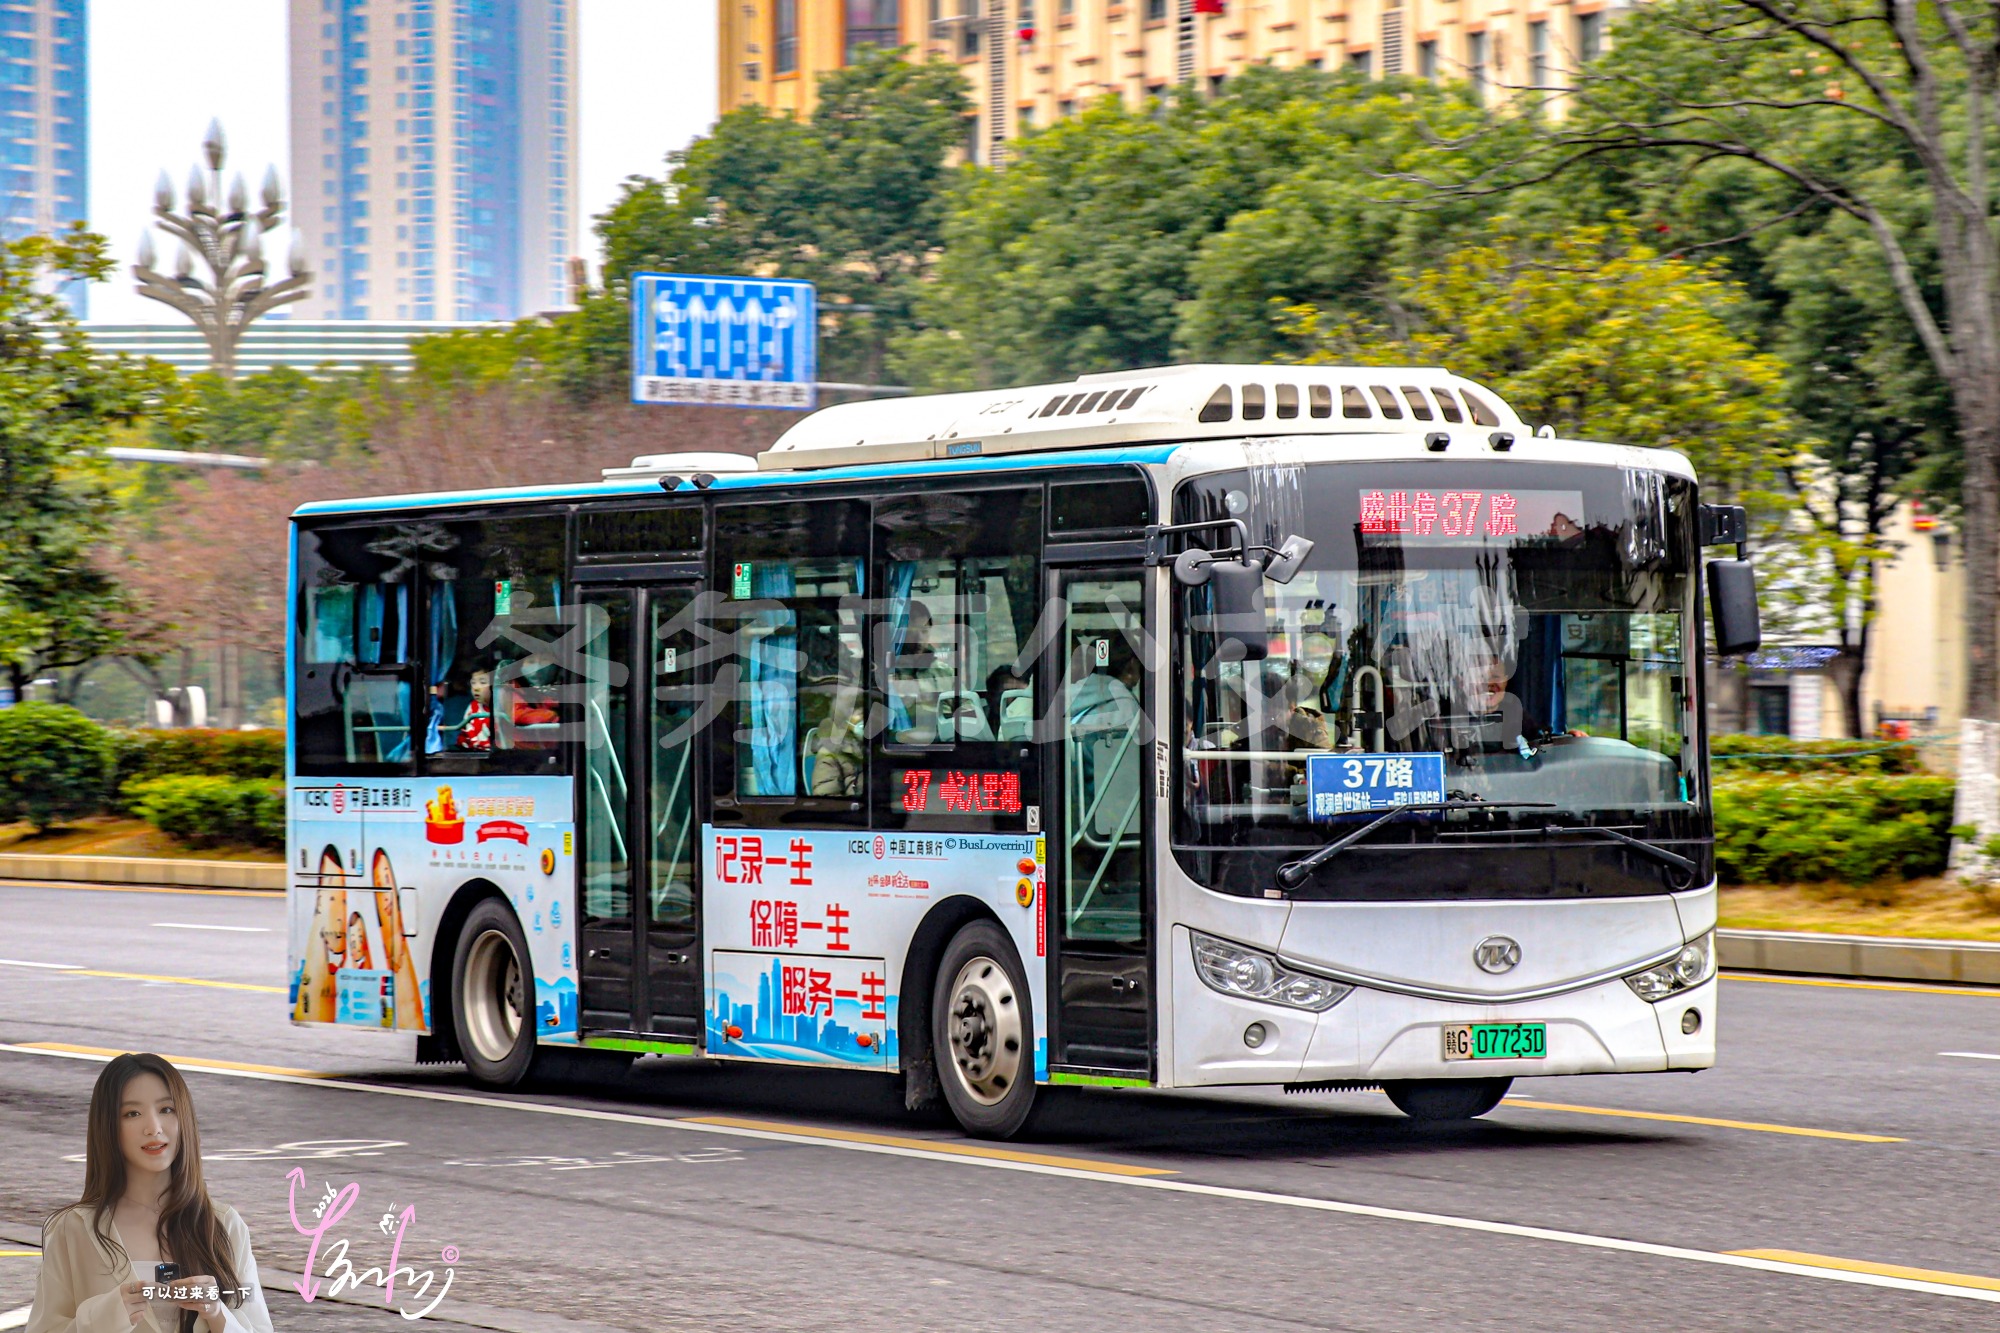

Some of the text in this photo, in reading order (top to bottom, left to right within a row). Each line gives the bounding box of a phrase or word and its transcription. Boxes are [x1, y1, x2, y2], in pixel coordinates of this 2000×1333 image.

[1343, 758, 1413, 788] 37路
[715, 836, 813, 886] 记录一生
[848, 840, 870, 853] ICBC
[890, 839, 943, 856] 中国工商银行
[750, 899, 850, 951] 保障一生
[782, 966, 885, 1020] 服务一生
